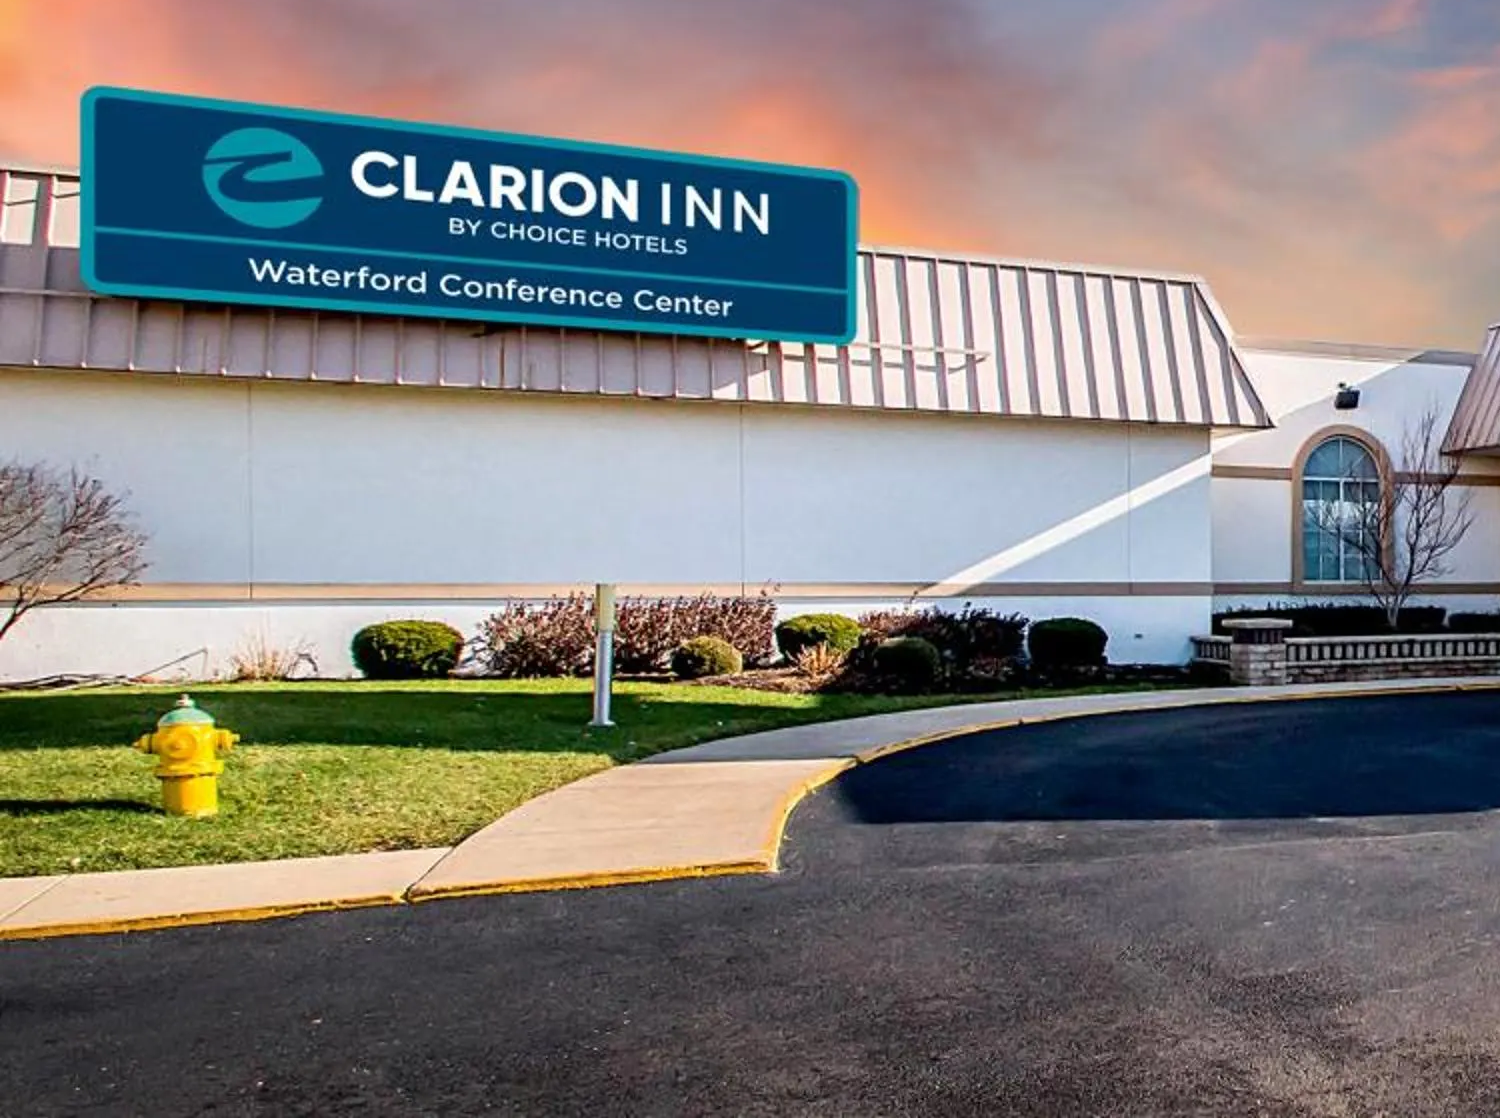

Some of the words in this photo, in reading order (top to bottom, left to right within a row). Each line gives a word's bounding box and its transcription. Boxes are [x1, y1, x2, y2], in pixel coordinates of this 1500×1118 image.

[350, 150, 640, 223] CLARION
[660, 183, 770, 236] INN
[448, 217, 481, 236] BY
[490, 221, 586, 246] CHOICE
[594, 231, 688, 256] HOTELS
[248, 258, 428, 294] Waterford
[438, 274, 624, 310] Conference
[632, 289, 734, 317] Center
